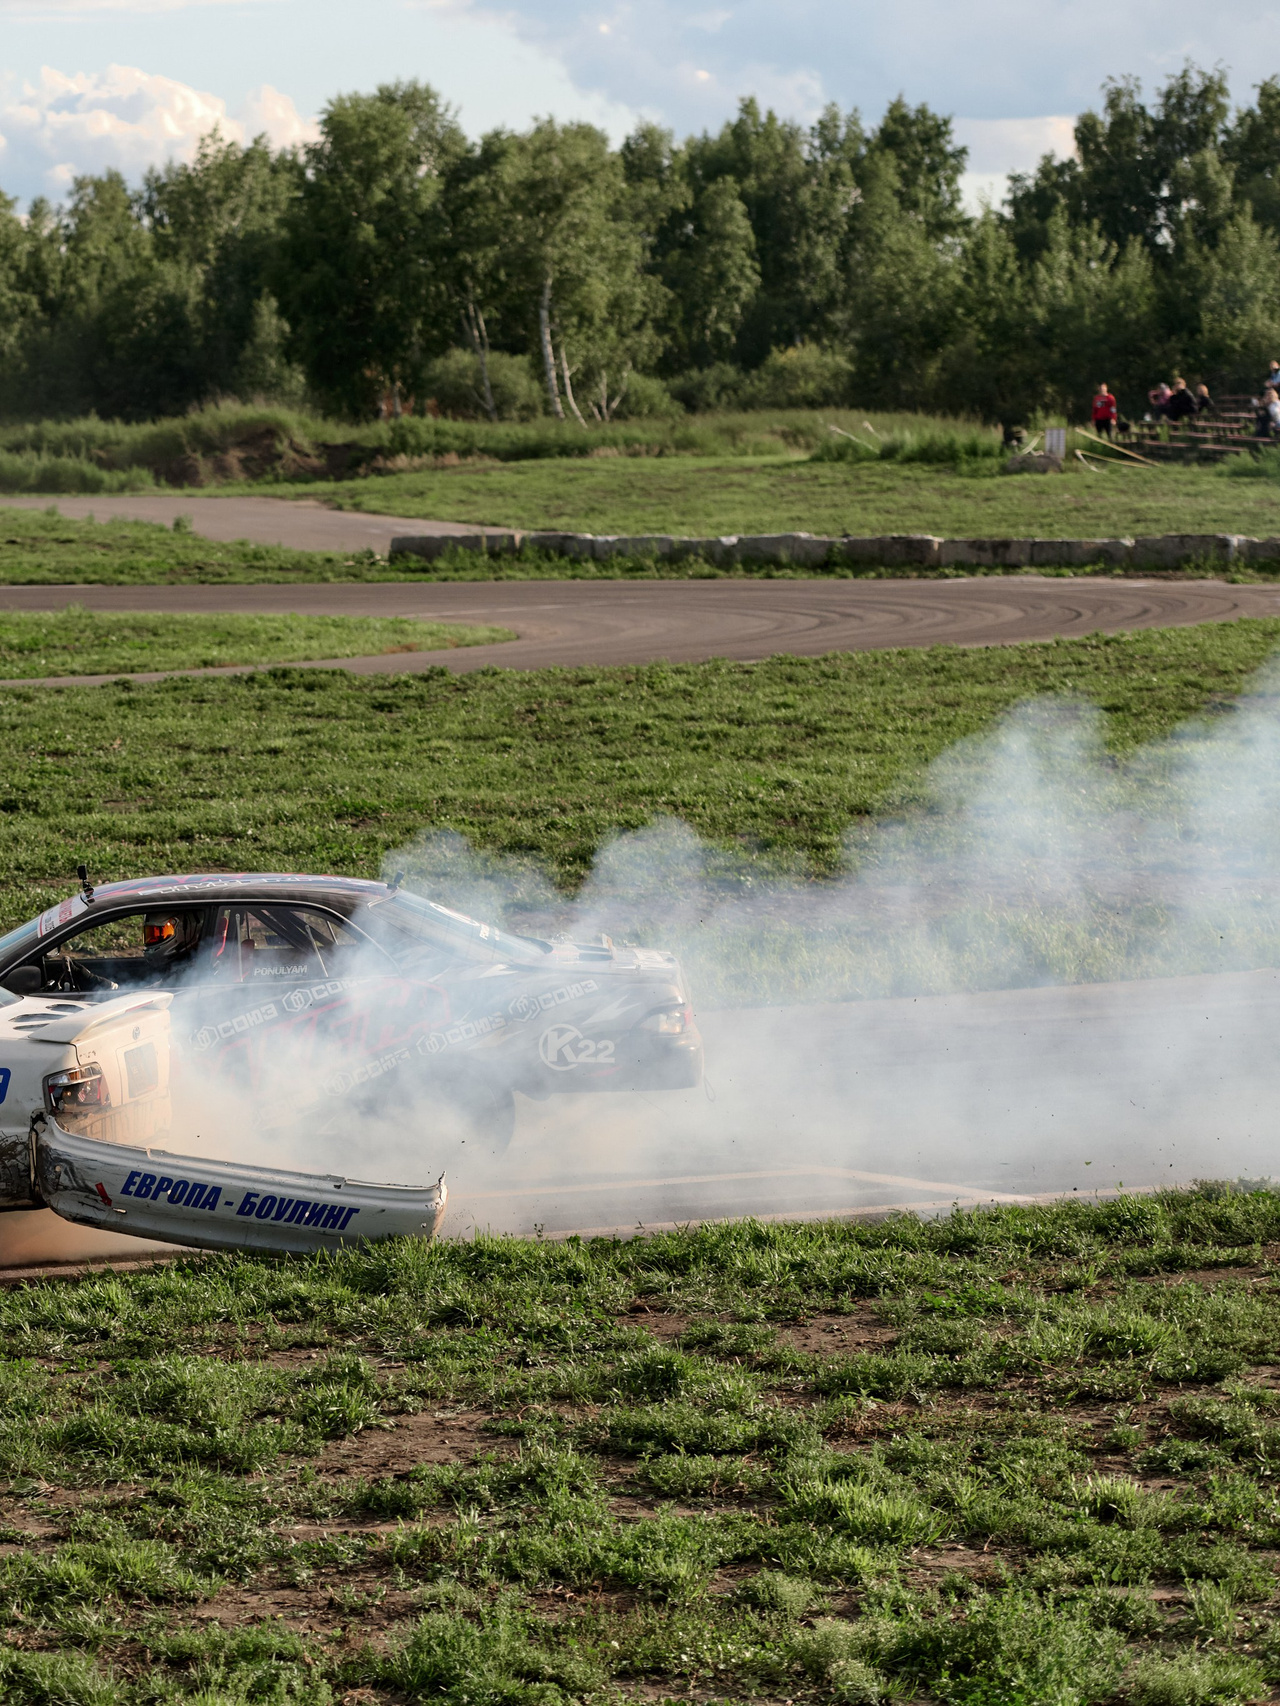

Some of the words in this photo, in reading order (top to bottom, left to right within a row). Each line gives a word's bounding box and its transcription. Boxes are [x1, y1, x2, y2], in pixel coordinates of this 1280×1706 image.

[253, 965, 308, 976] PONULYAM
[547, 1031, 616, 1063] K22
[120, 1170, 222, 1212] ЕВРОПА
[236, 1191, 360, 1230] БОУЛИНГ
